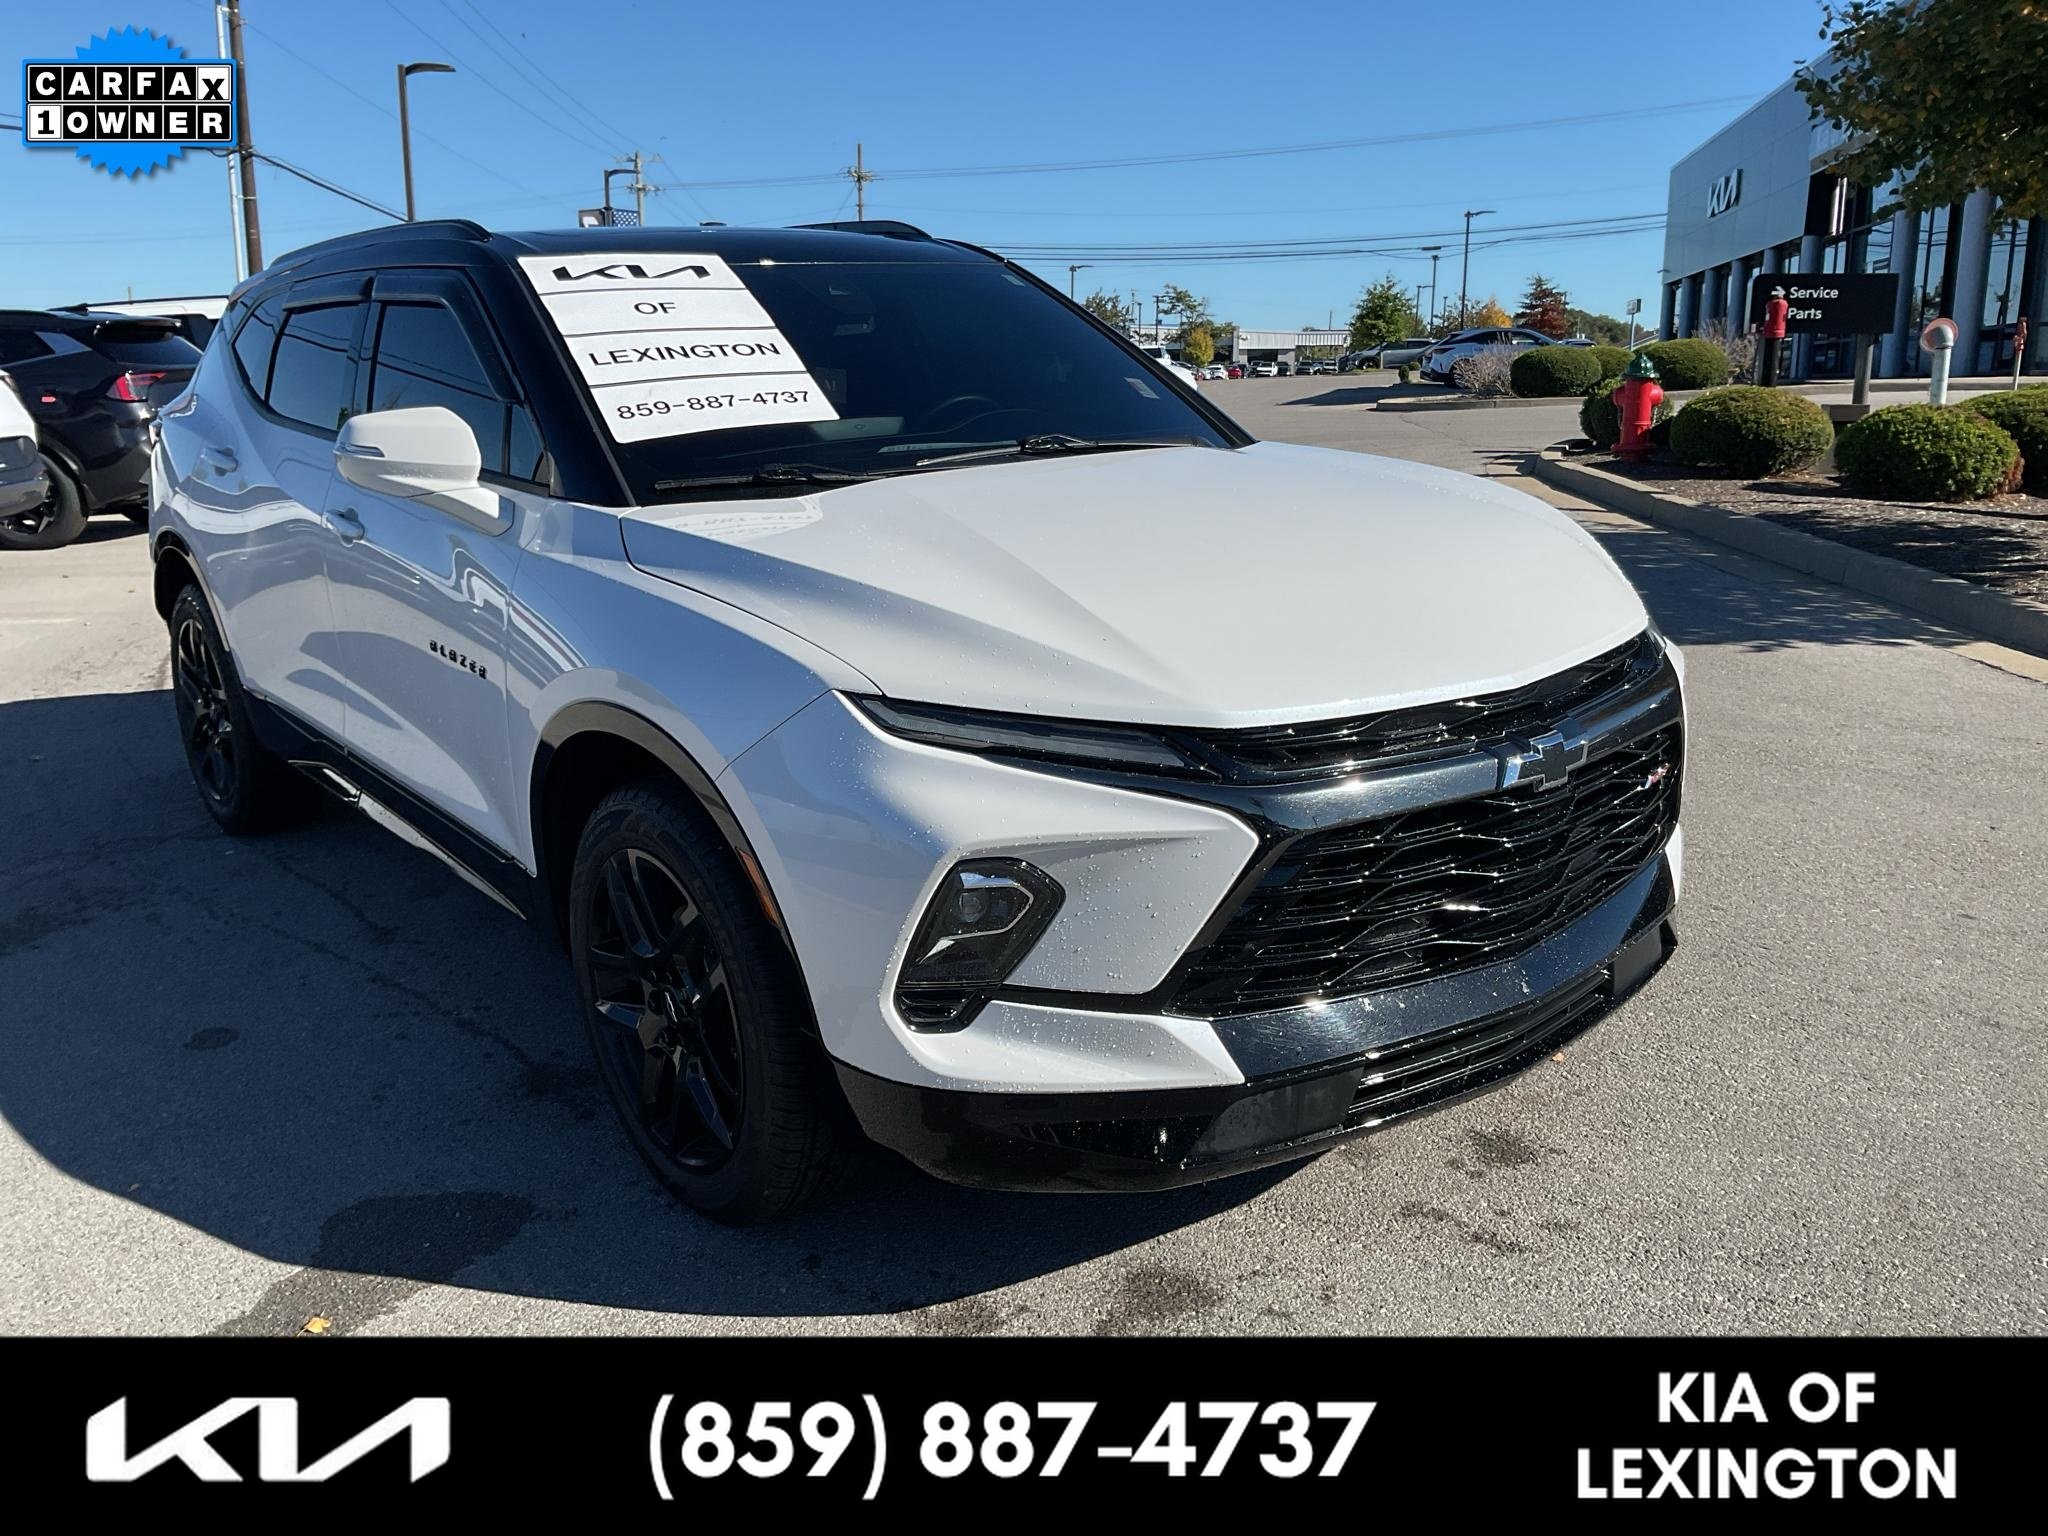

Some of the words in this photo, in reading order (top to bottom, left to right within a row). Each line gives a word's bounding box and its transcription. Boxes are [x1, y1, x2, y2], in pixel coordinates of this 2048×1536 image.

[1789, 286, 1839, 298] Service
[633, 302, 676, 315] OF
[1787, 307, 1822, 319] Parts
[588, 343, 781, 366] LEXINGTON
[616, 390, 809, 420] 859-887-4737
